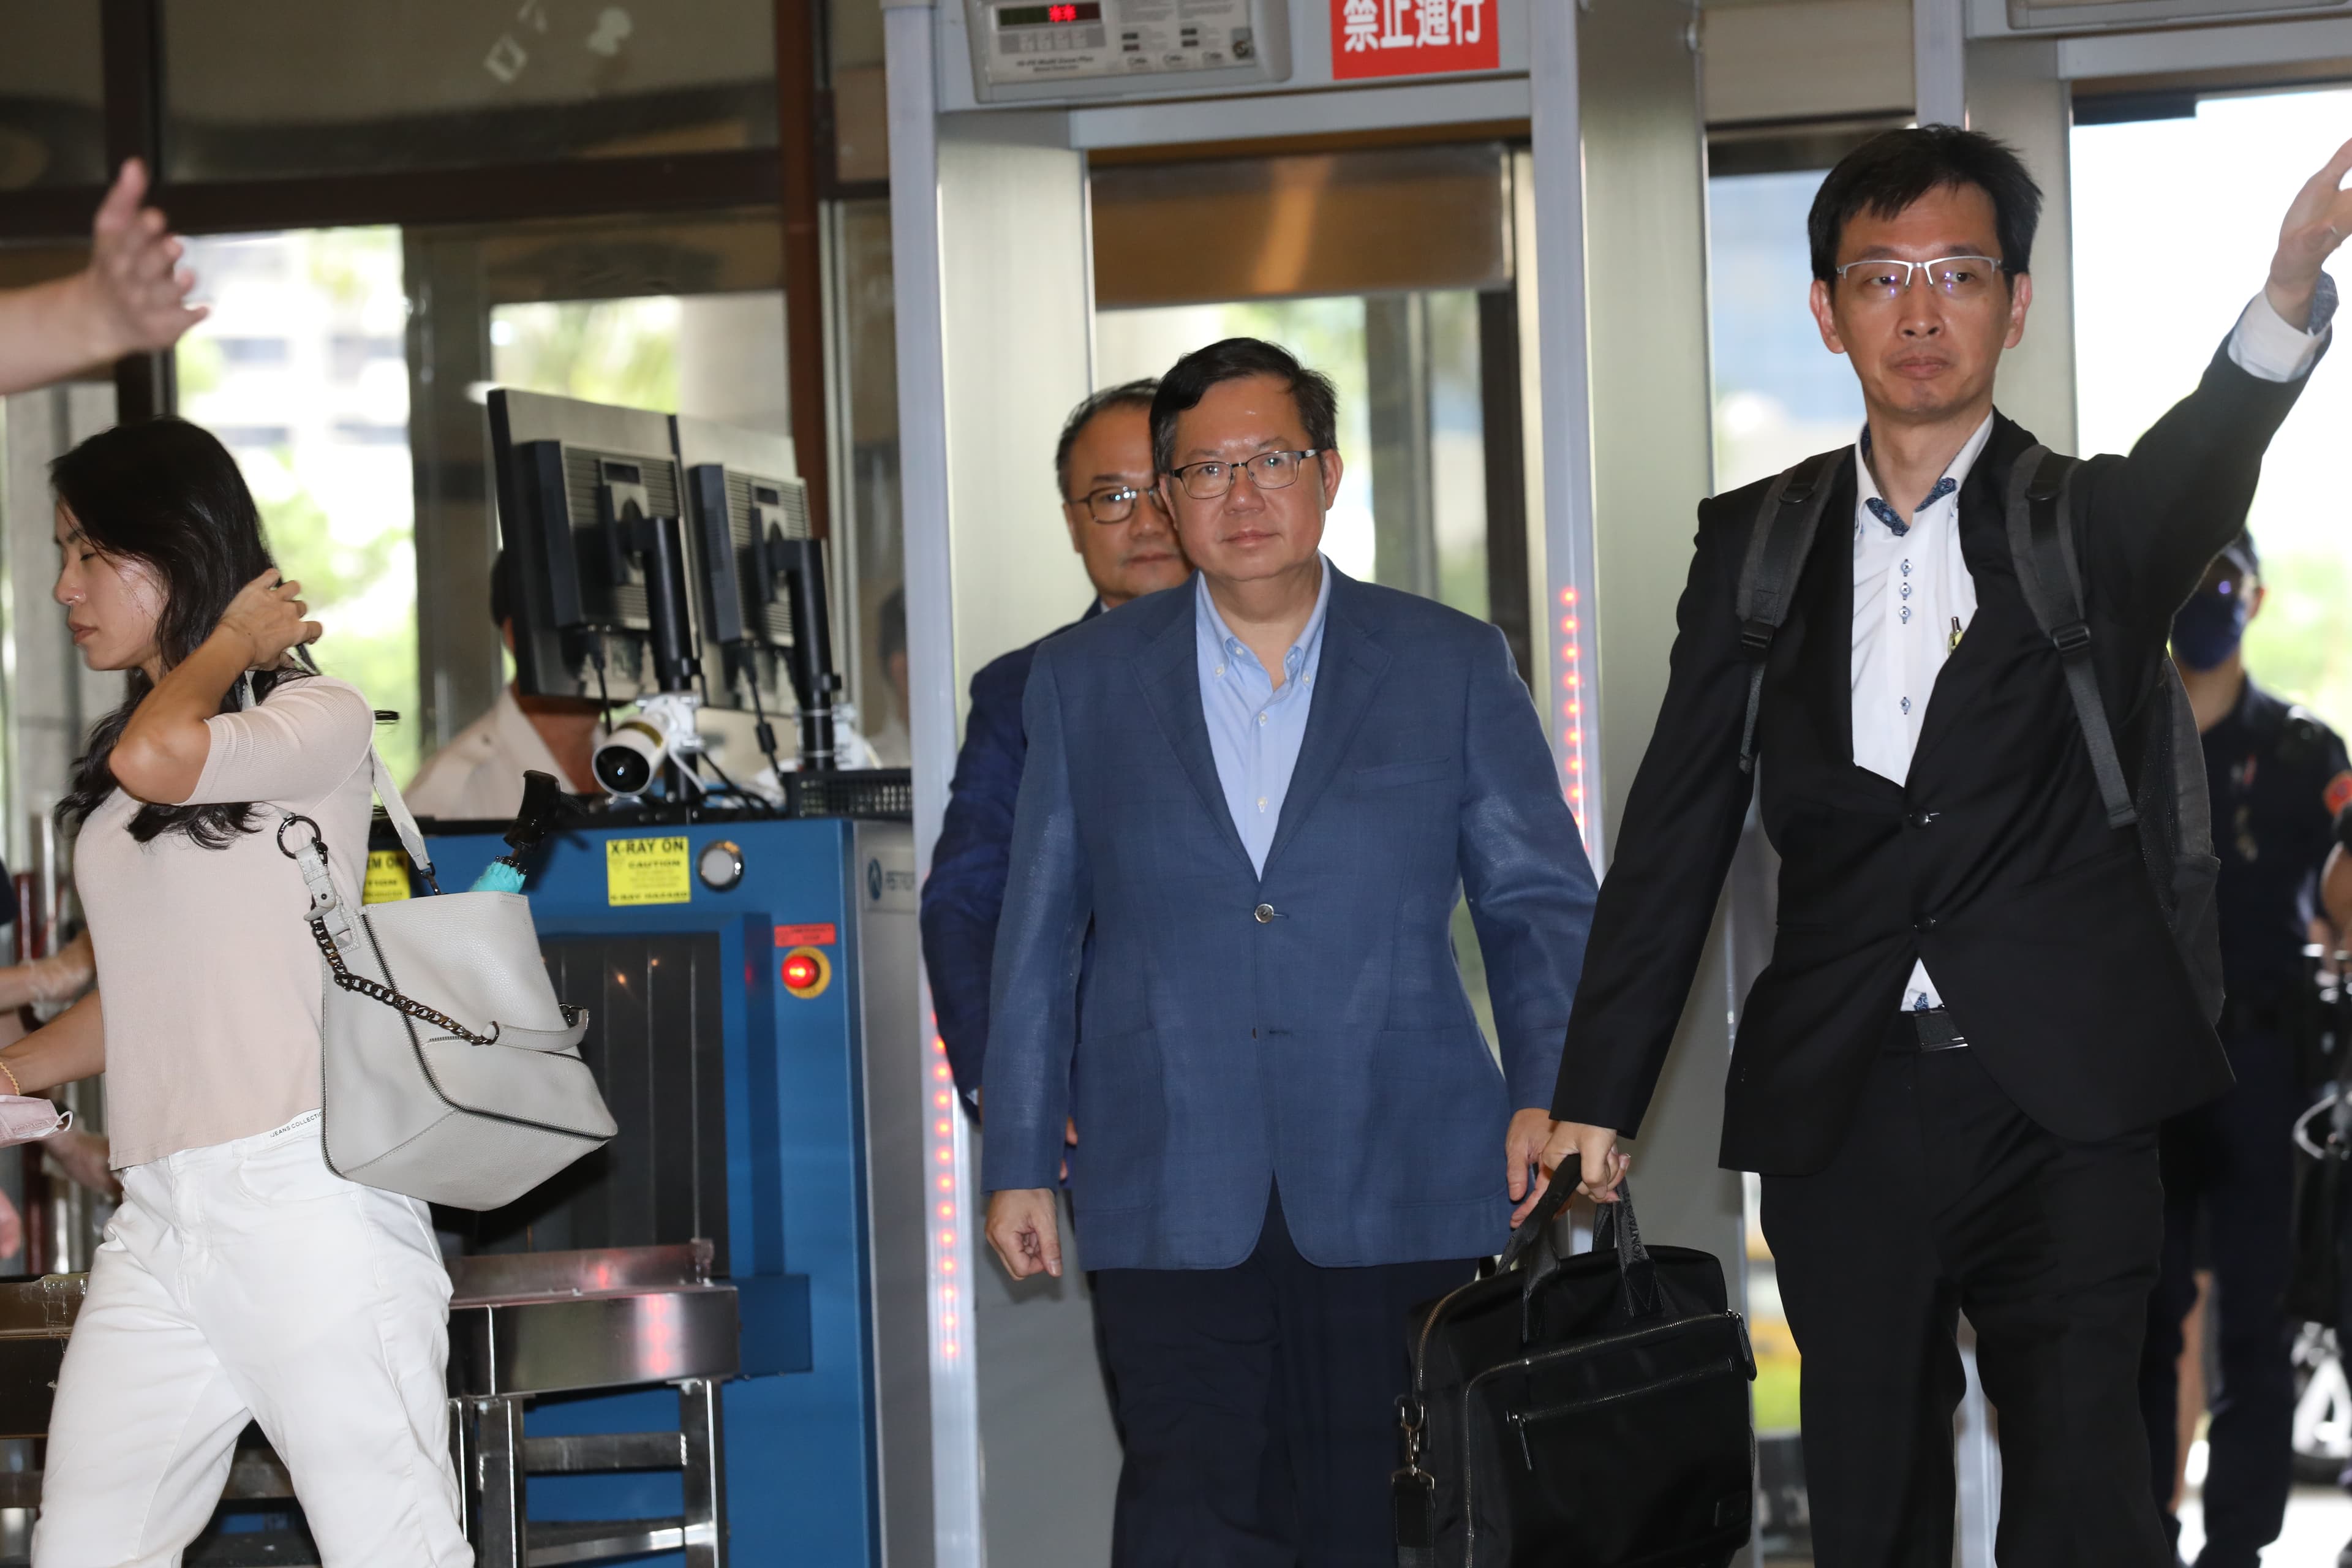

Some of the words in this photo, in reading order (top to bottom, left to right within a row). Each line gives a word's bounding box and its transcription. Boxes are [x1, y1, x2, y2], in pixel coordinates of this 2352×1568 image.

[1343, 0, 1485, 52] 禁止通行
[611, 838, 655, 855] X-RAY
[662, 837, 684, 853] ON
[628, 860, 680, 869] CAUTION
[270, 1126, 290, 1137] JEANS
